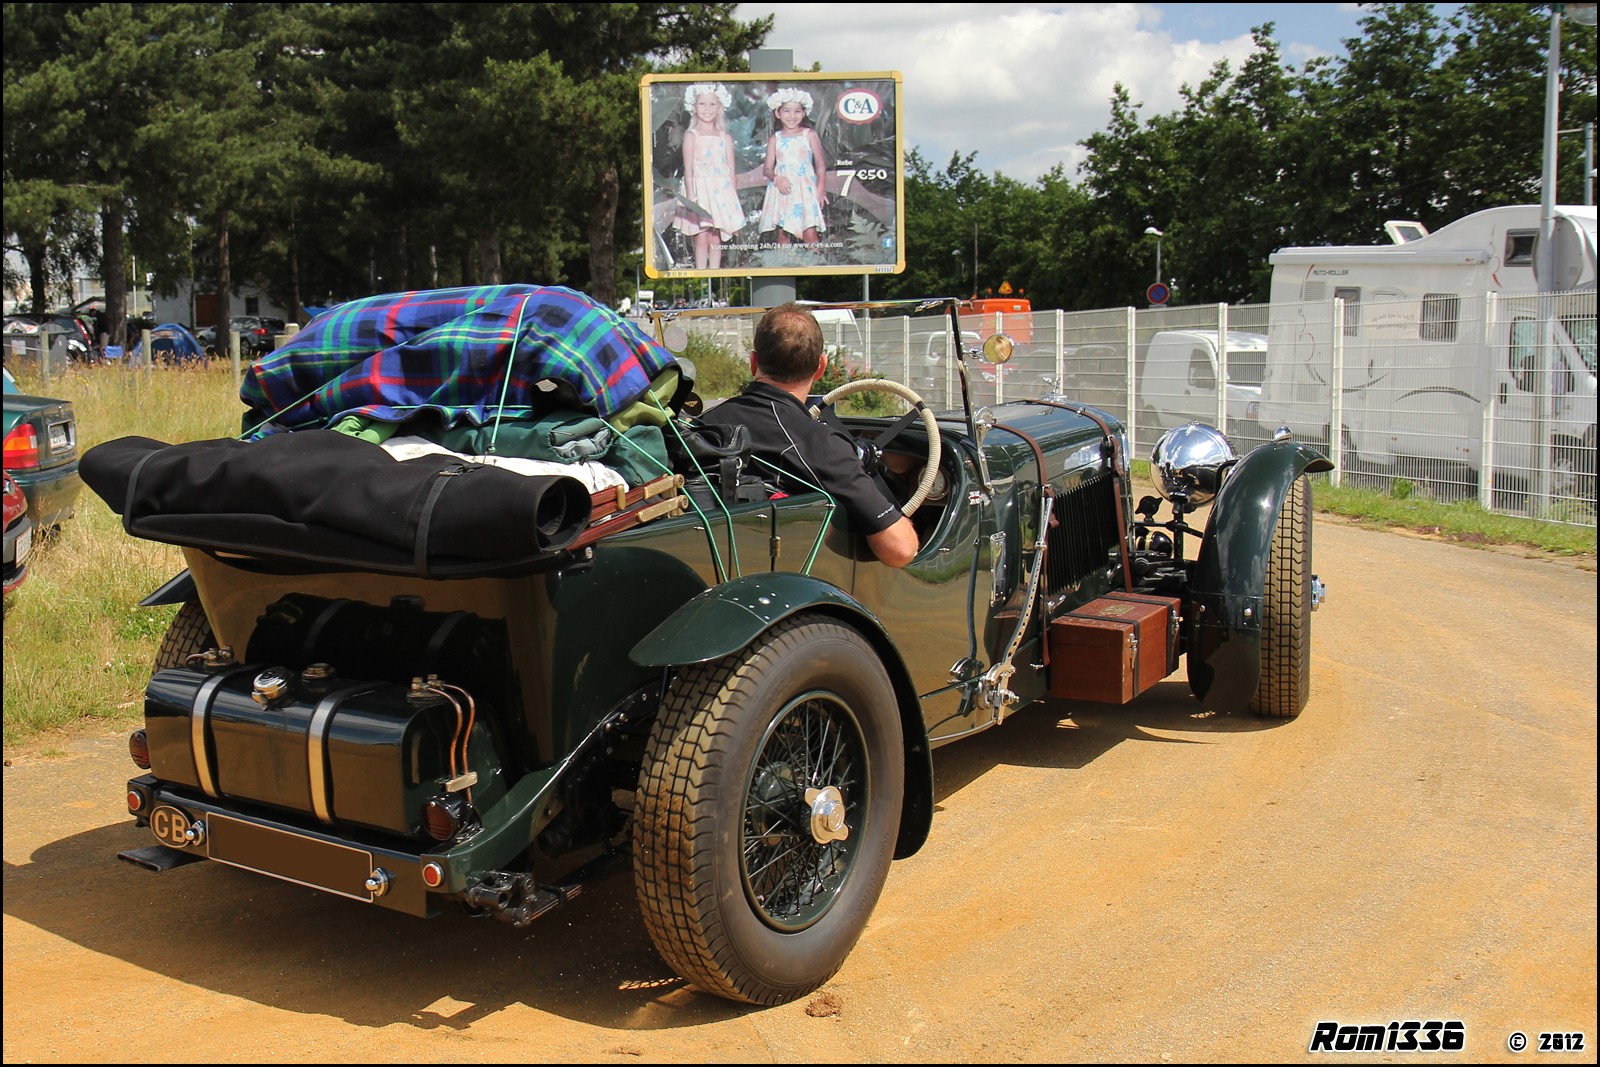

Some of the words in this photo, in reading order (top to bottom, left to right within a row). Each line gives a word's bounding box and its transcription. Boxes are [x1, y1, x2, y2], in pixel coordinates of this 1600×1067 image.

[843, 98, 874, 114] C&A
[710, 243, 728, 251] Votre
[729, 242, 758, 251] shopping
[793, 240, 844, 249] www.c-et-a.com
